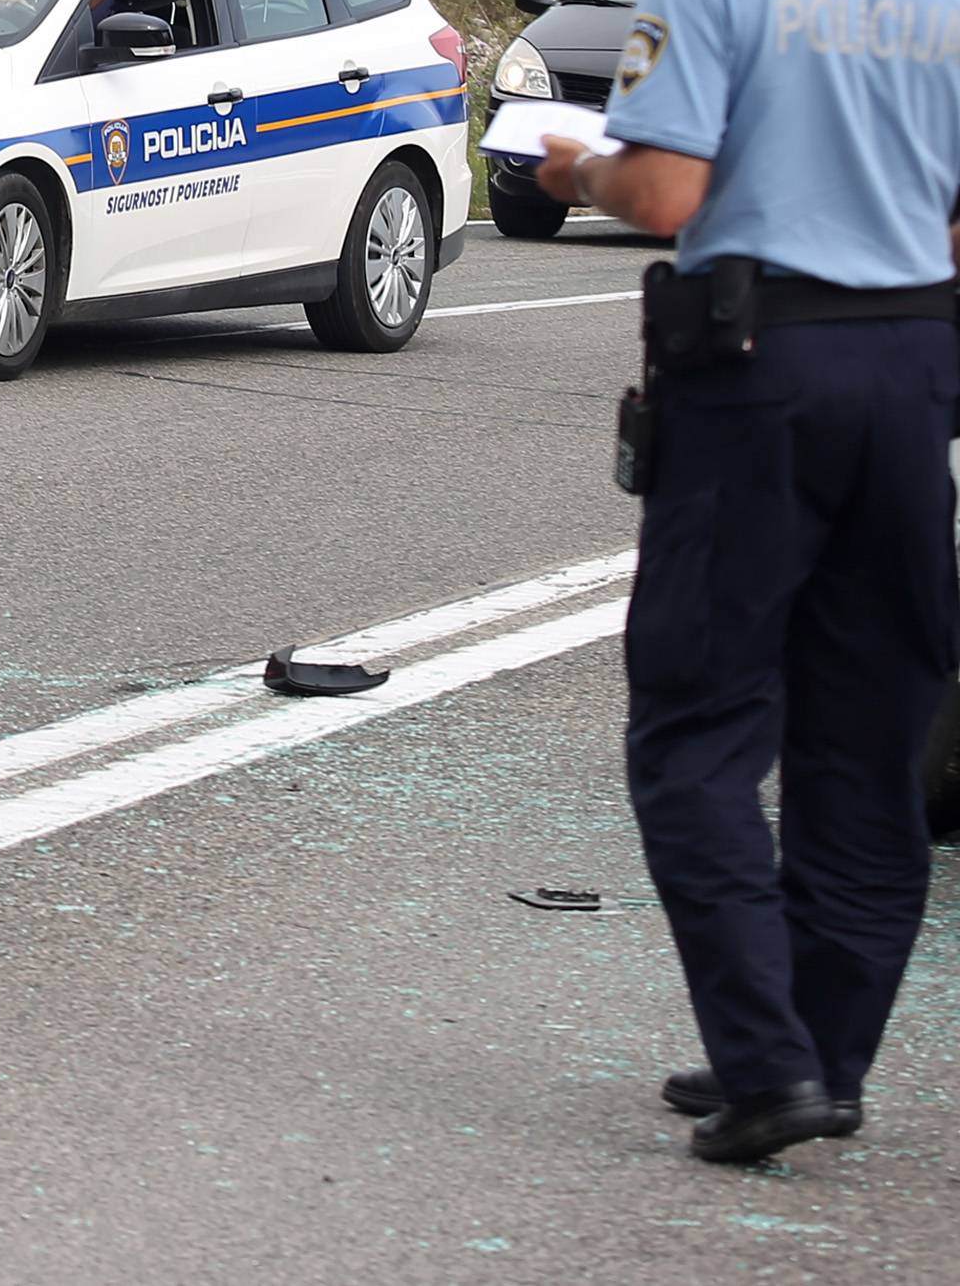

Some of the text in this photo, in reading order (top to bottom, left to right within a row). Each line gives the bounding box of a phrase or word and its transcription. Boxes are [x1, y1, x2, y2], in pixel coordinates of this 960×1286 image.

[143, 118, 247, 161] POLICIJA
[106, 175, 240, 215] SIGURNOST I POVJERENJE
